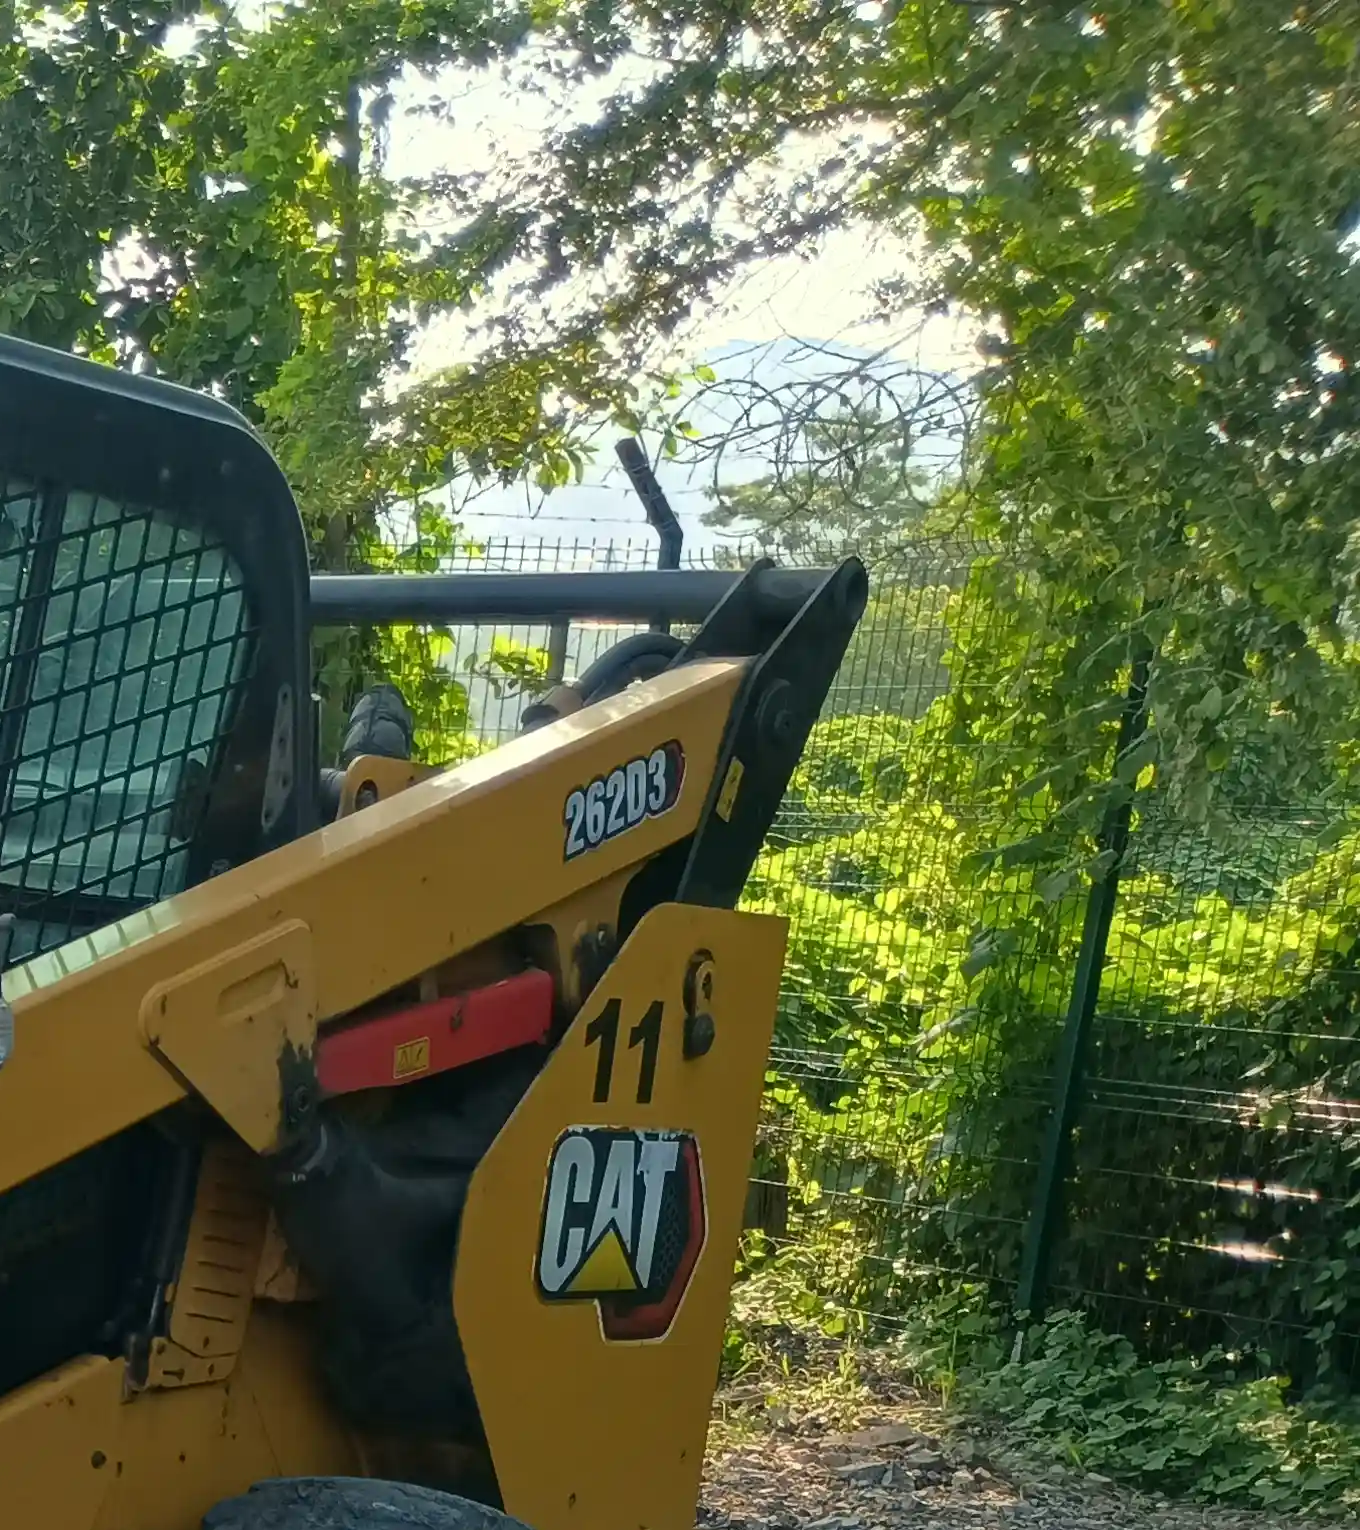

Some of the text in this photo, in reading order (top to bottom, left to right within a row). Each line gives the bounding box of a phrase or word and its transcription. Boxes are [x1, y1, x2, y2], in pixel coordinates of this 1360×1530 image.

[565, 749, 667, 856] 262D3
[584, 998, 664, 1103] 11
[540, 1136, 679, 1292] CAT
